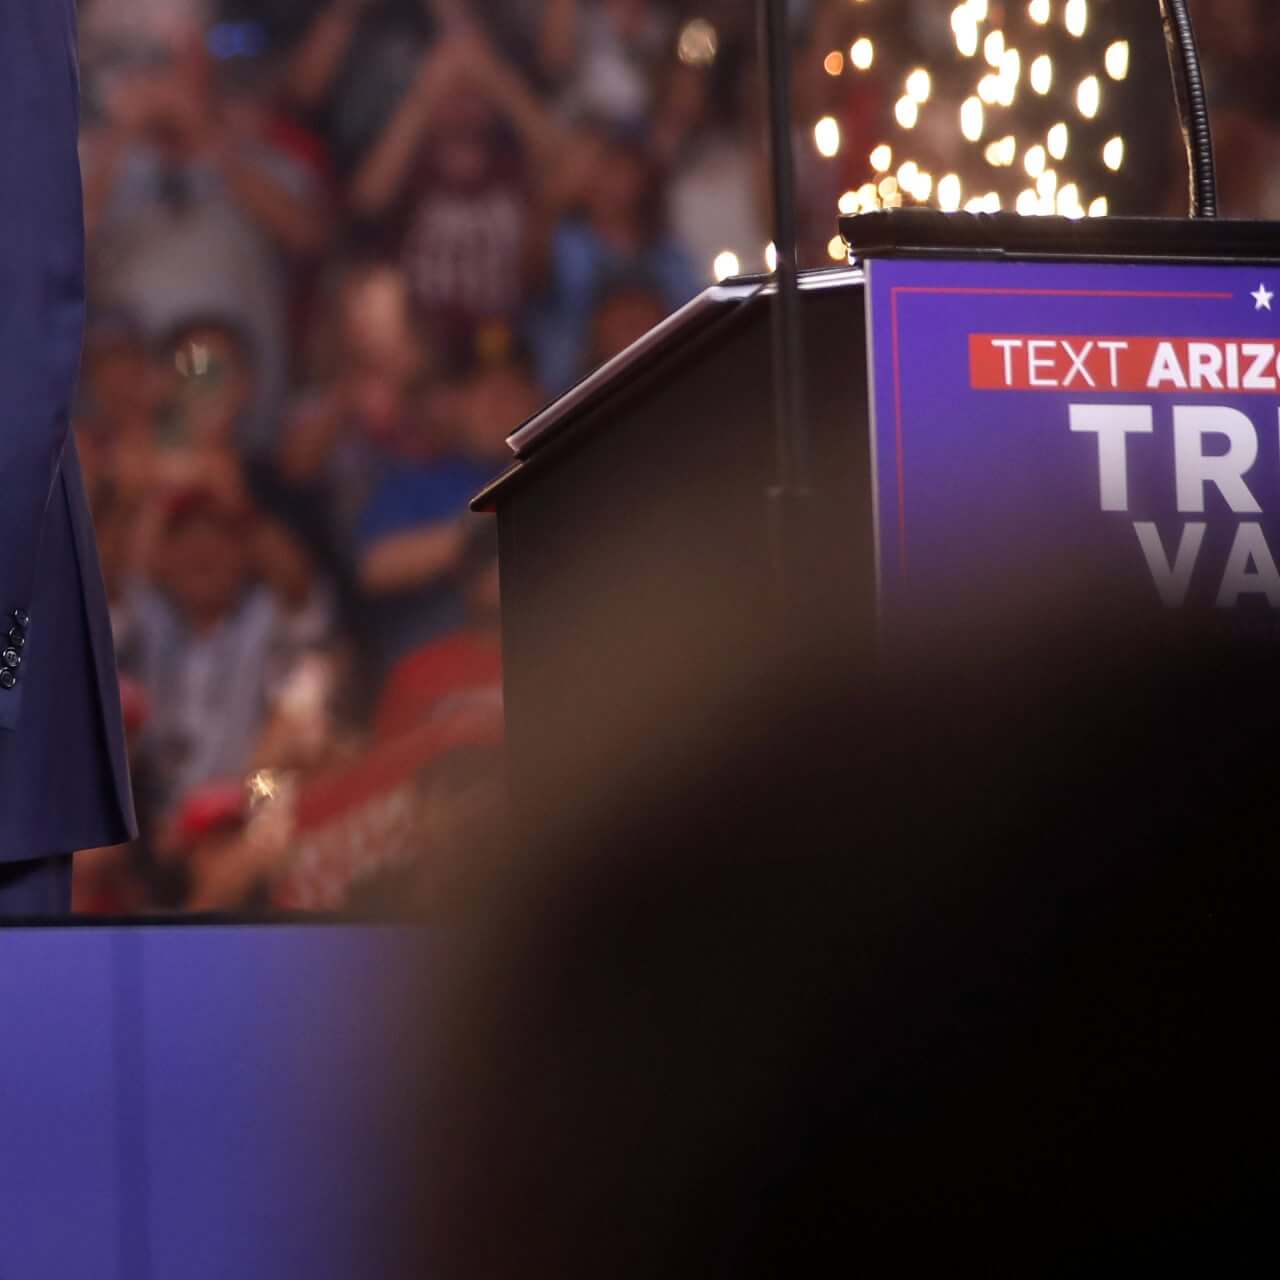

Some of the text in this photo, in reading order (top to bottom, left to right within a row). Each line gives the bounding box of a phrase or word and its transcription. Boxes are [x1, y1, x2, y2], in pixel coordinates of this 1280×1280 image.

[991, 338, 1280, 390] TEXT ARIZ
[1068, 403, 1280, 513] TR
[1132, 521, 1280, 609] VA
